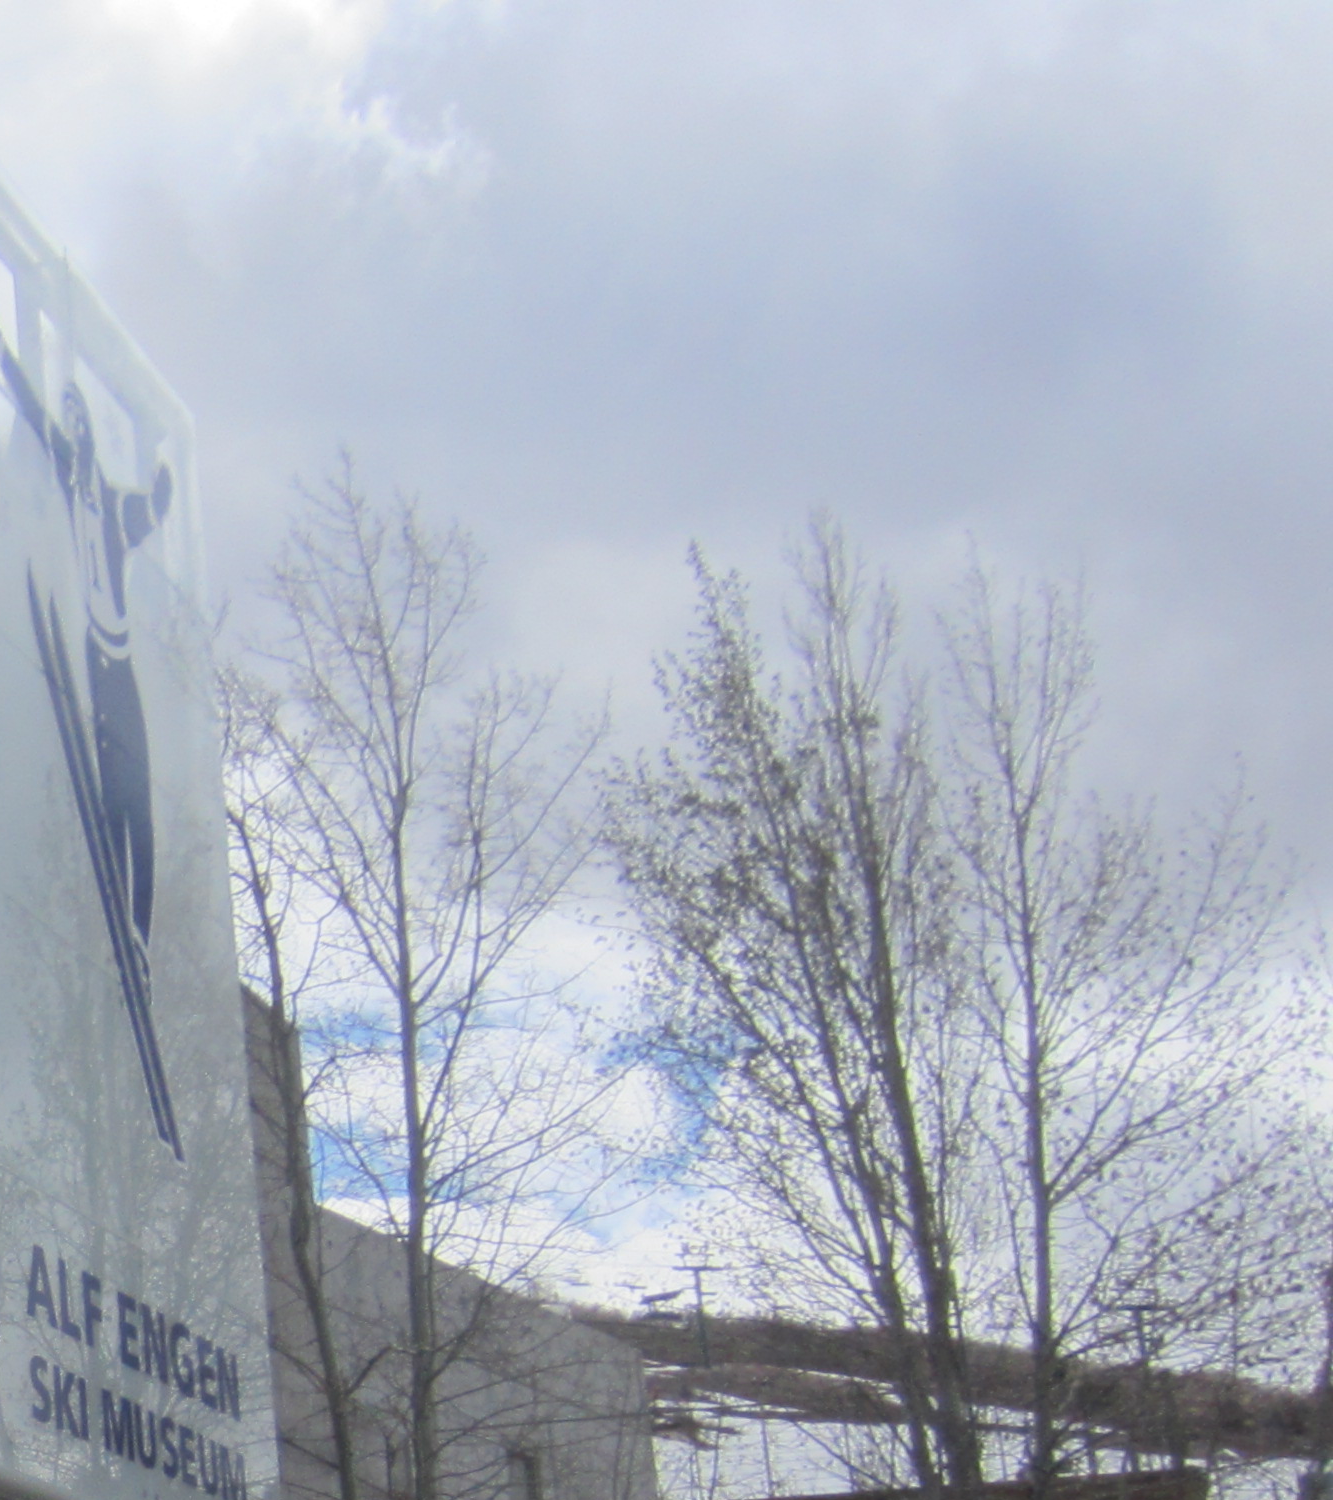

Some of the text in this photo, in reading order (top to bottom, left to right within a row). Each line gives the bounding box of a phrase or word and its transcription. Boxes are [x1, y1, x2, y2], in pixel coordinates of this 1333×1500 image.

[27, 1244, 240, 1422] ALF ENGEN
[29, 1355, 89, 1441] SKI
